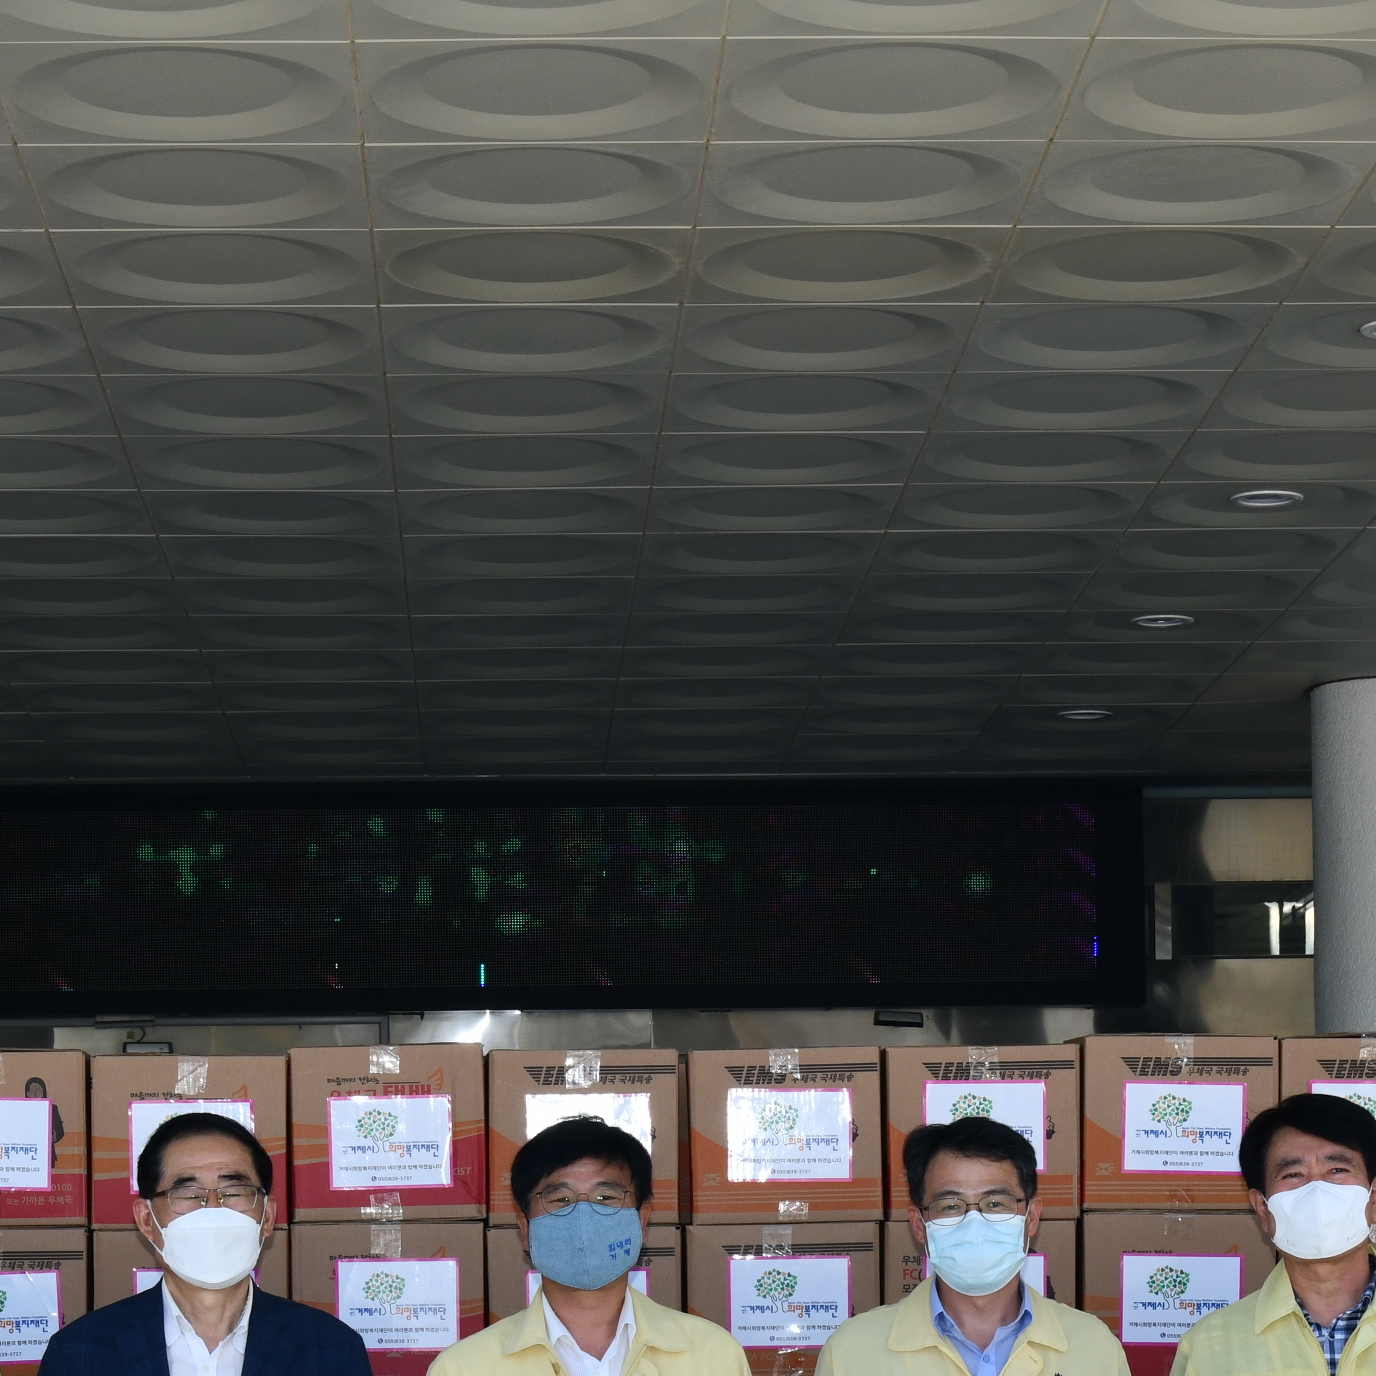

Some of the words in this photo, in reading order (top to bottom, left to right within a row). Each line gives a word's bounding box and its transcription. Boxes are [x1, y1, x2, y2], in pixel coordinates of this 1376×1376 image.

[1018, 1070, 1052, 1080] 국제특송
[1215, 1066, 1249, 1076] 국제특송
[598, 1075, 616, 1084] 체국
[619, 1074, 653, 1084] 국제특송
[820, 1073, 854, 1083] 국제특송
[1142, 1129, 1167, 1138] 거제시
[1181, 1129, 1232, 1145] 희망복지재단
[787, 1137, 839, 1152] 희망복지재단
[348, 1146, 374, 1155] 거제시
[388, 1144, 439, 1158] 희망복지재단
[21, 1196, 45, 1206] 가까운
[48, 1196, 72, 1206] 우체국
[27, 1261, 62, 1270] 국제특송
[1138, 1301, 1165, 1310] 거제시
[355, 1308, 381, 1317] 거제시
[395, 1307, 446, 1321] 희망복지재단
[747, 1304, 773, 1313] 거제시
[786, 1304, 838, 1318] 희망복지재단
